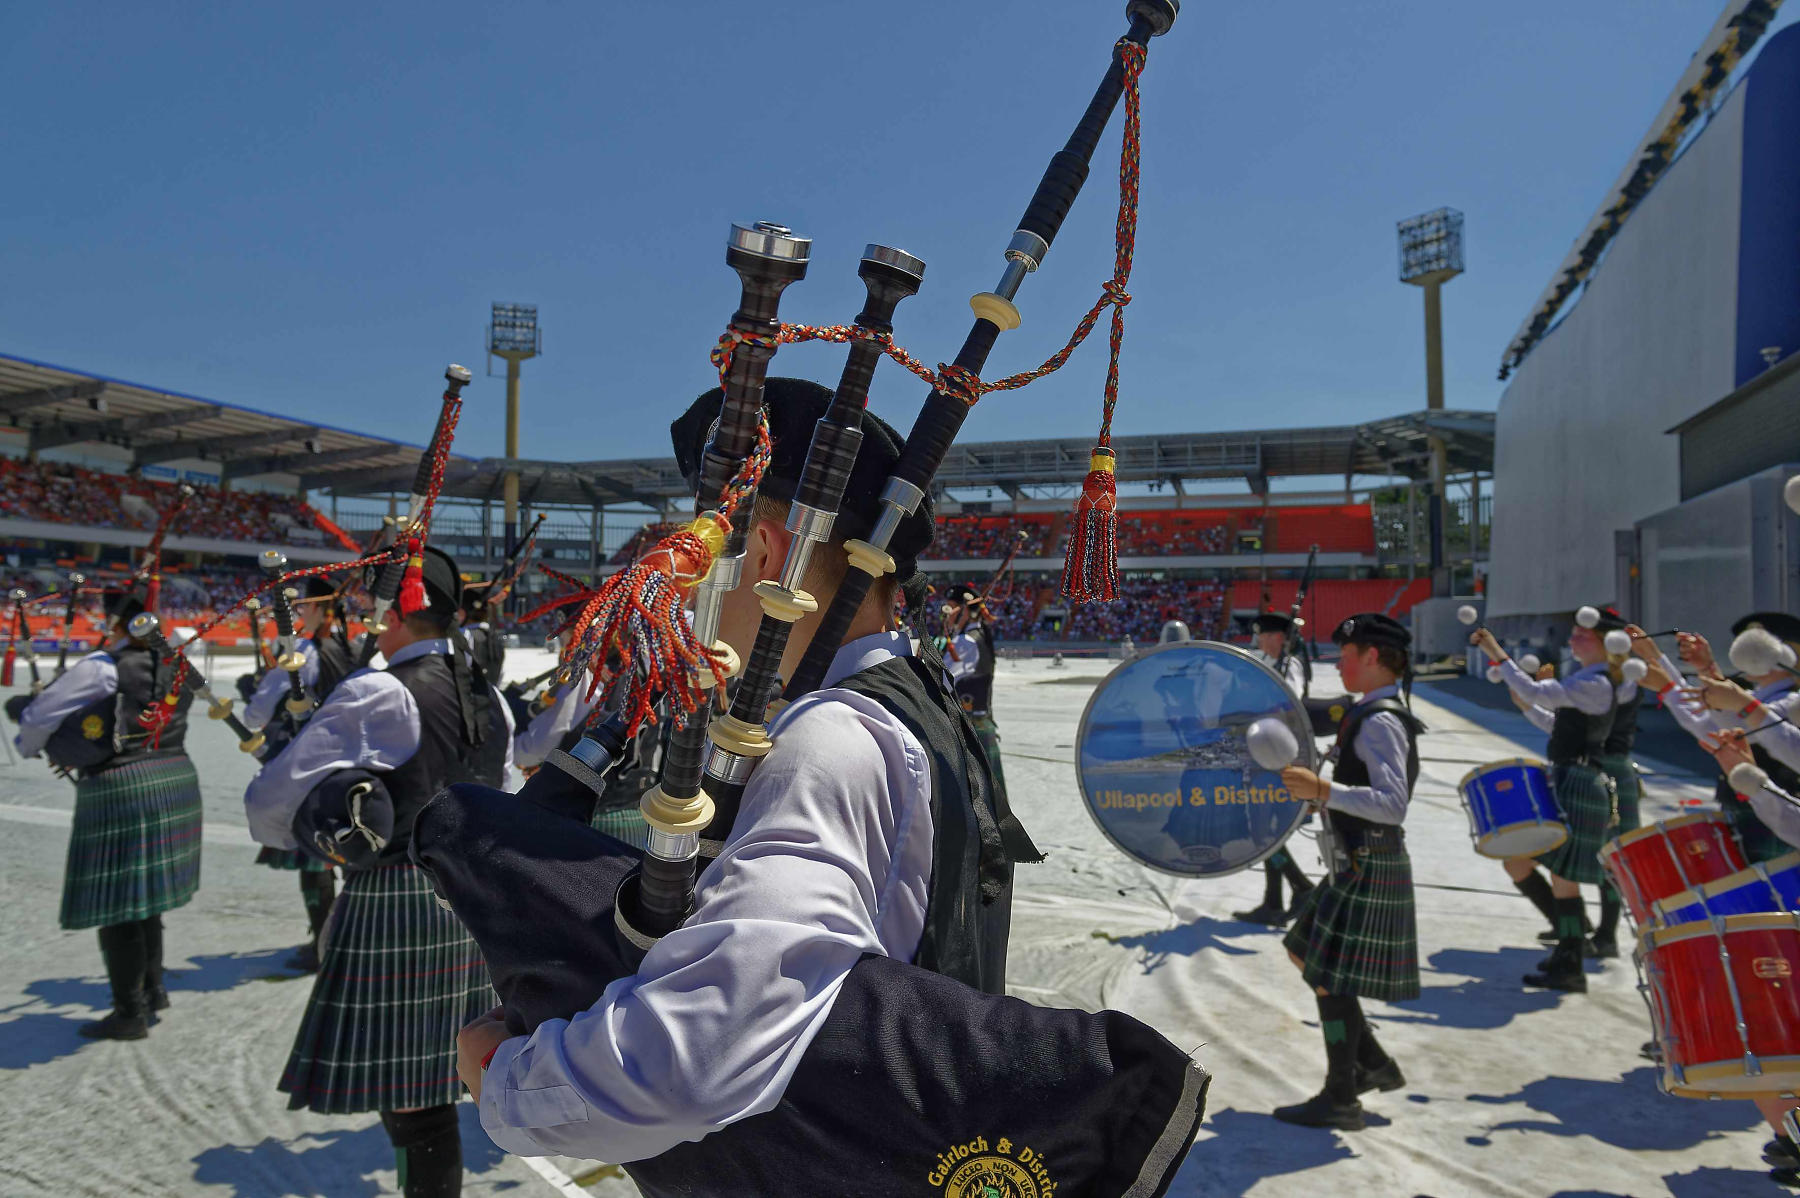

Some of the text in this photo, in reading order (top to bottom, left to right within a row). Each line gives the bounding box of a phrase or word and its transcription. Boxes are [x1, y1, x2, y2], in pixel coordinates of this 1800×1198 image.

[1096, 788, 1182, 811] Ullapool
[1190, 787, 1206, 806] &
[928, 1136, 988, 1186] Gairloch
[997, 1137, 1013, 1154] &
[954, 1162, 983, 1187] LUCEO
[993, 1162, 1016, 1176] NON
